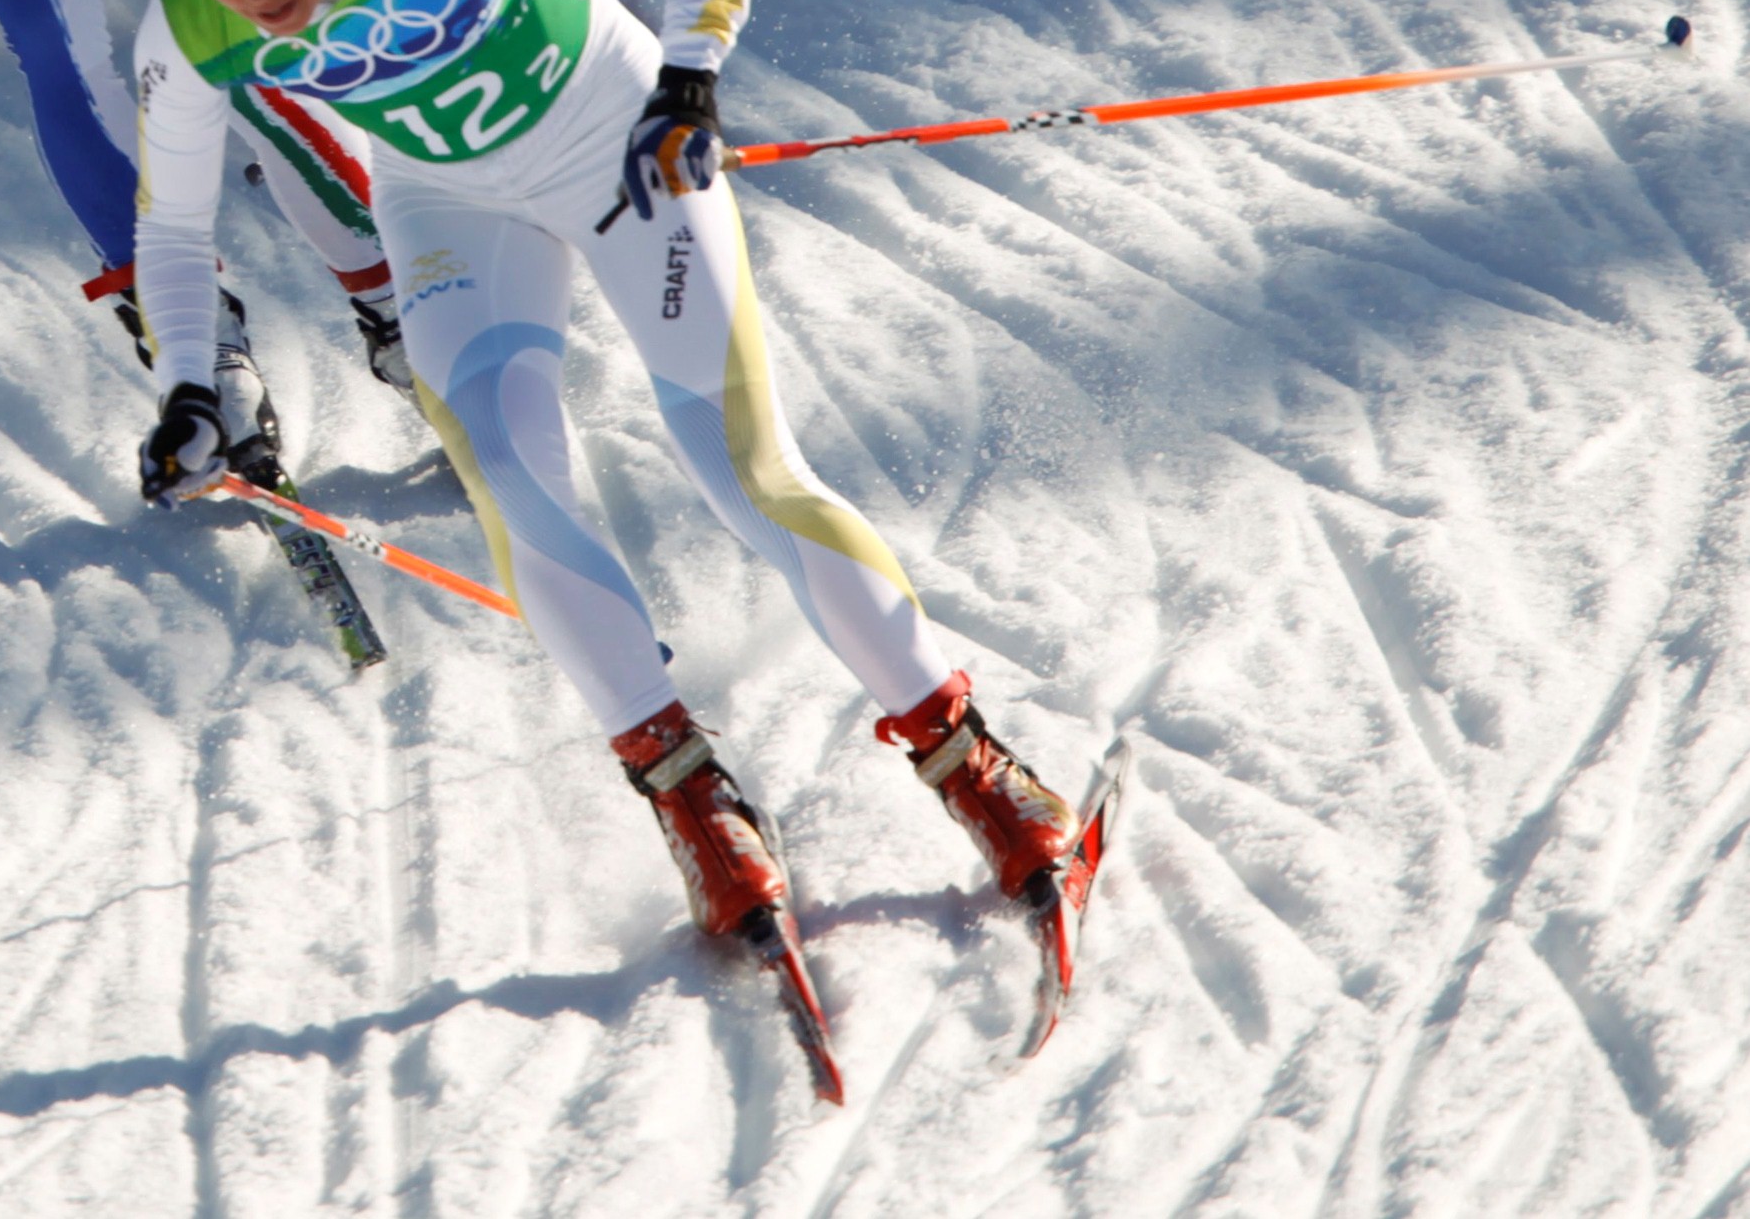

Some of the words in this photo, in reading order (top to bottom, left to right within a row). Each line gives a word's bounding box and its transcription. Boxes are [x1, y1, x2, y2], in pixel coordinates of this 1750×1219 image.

[382, 70, 530, 156] 12
[525, 43, 571, 93] 2
[401, 279, 477, 317] SWE
[661, 245, 691, 320] CRAFT
